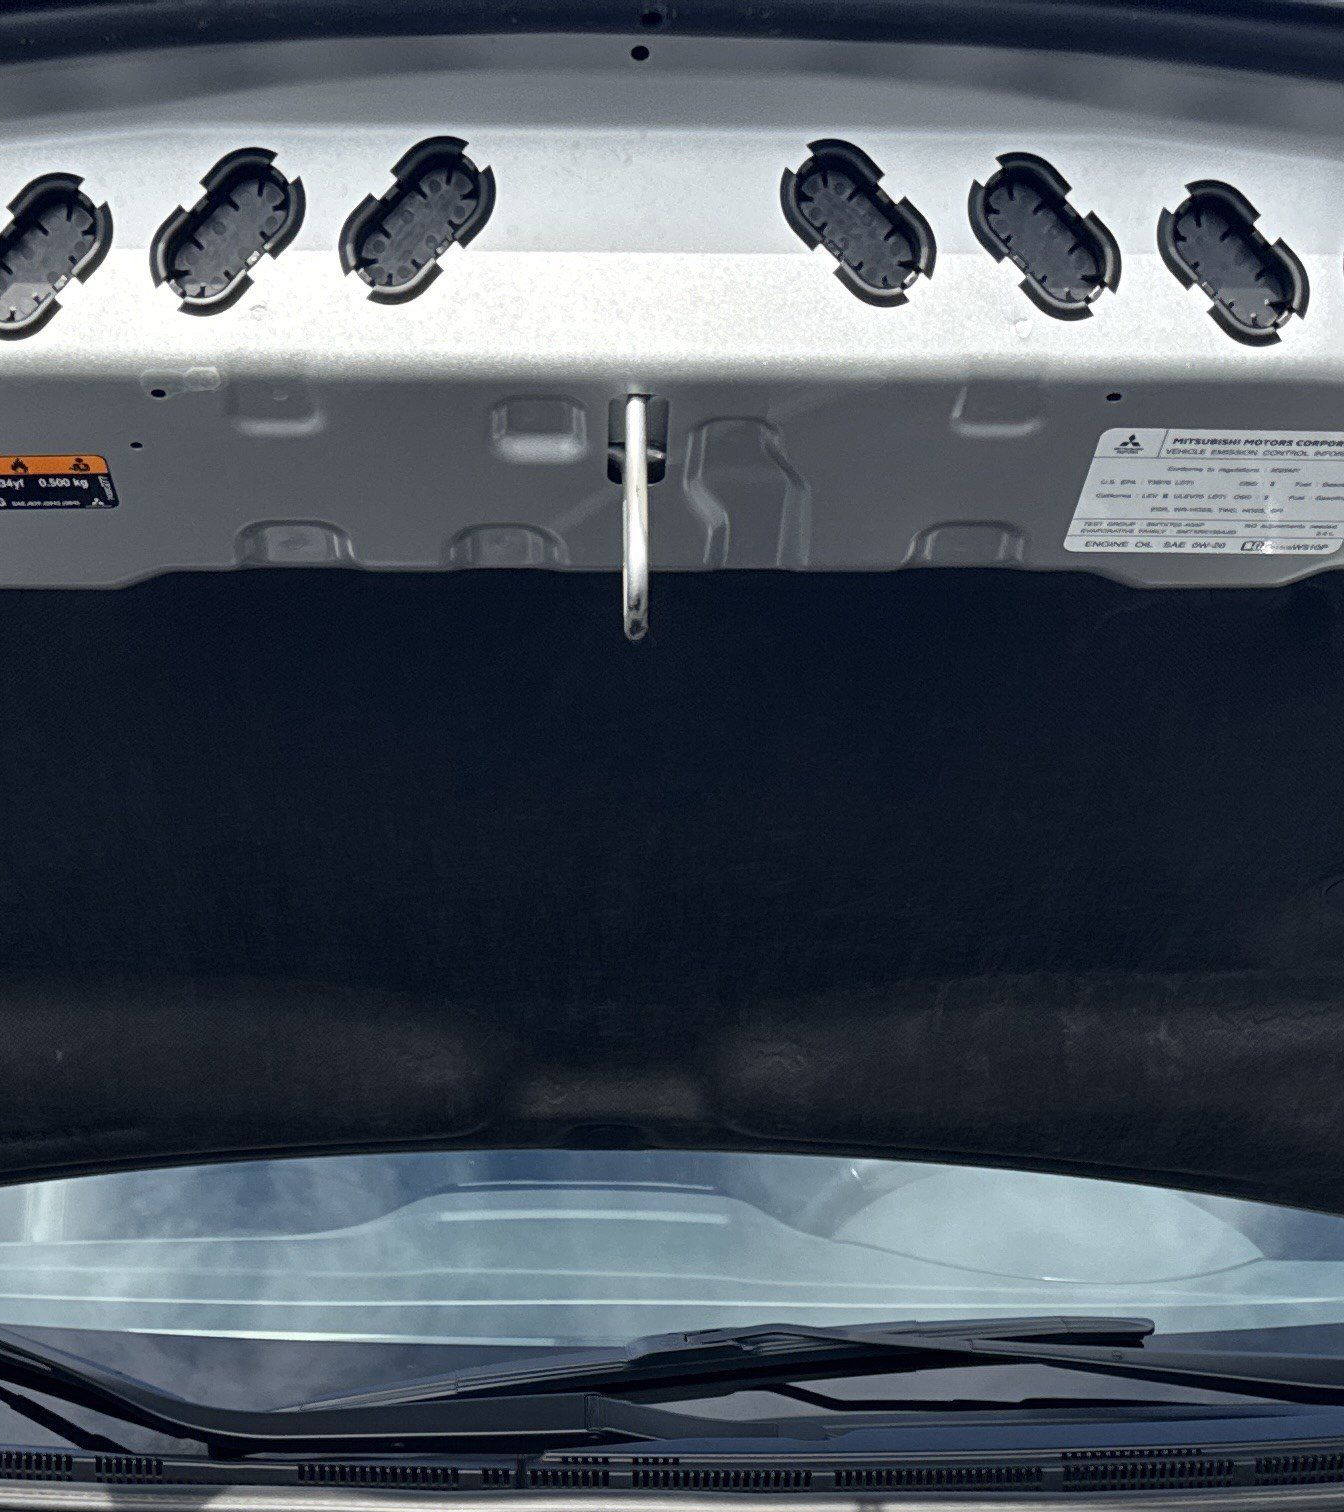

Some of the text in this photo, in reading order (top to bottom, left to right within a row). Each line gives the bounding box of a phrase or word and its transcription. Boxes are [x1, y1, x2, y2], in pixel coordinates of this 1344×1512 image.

[1172, 437, 1242, 446] MITSUBISHI
[1243, 438, 1294, 447] MOTORS
[1262, 449, 1309, 457] CONTROL
[38, 477, 71, 488] 0.500
[72, 477, 90, 490] kg
[1134, 541, 1153, 549] OIL
[1162, 541, 1186, 549] SAE
[1191, 541, 1227, 549] 0W-20
